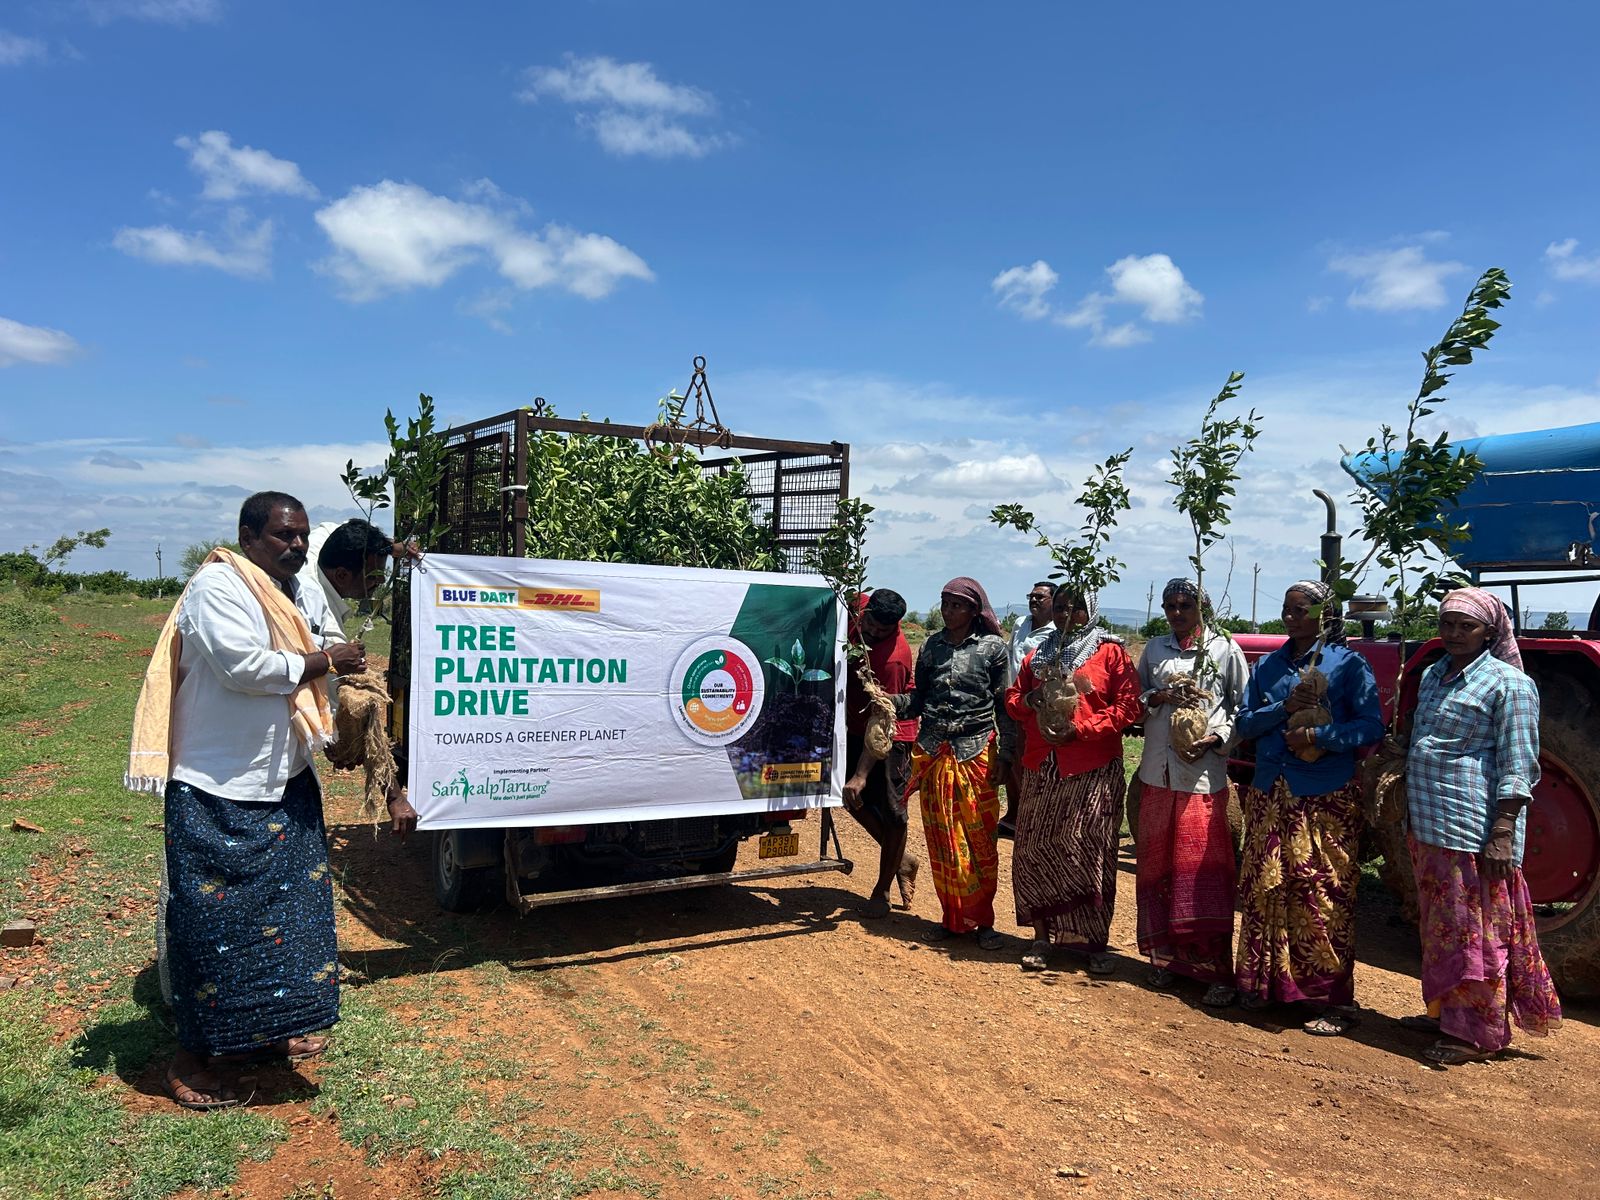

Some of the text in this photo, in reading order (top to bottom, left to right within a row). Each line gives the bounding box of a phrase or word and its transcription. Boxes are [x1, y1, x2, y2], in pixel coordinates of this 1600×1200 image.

[442, 589, 516, 604] BLUE DART
[527, 593, 592, 607] DHL
[435, 624, 516, 652] TREE
[434, 657, 627, 684] PLANTATION
[434, 689, 529, 716] DRIVE
[434, 729, 627, 745] TOWARDS A GREENER PLANET
[766, 846, 795, 857] P9050
